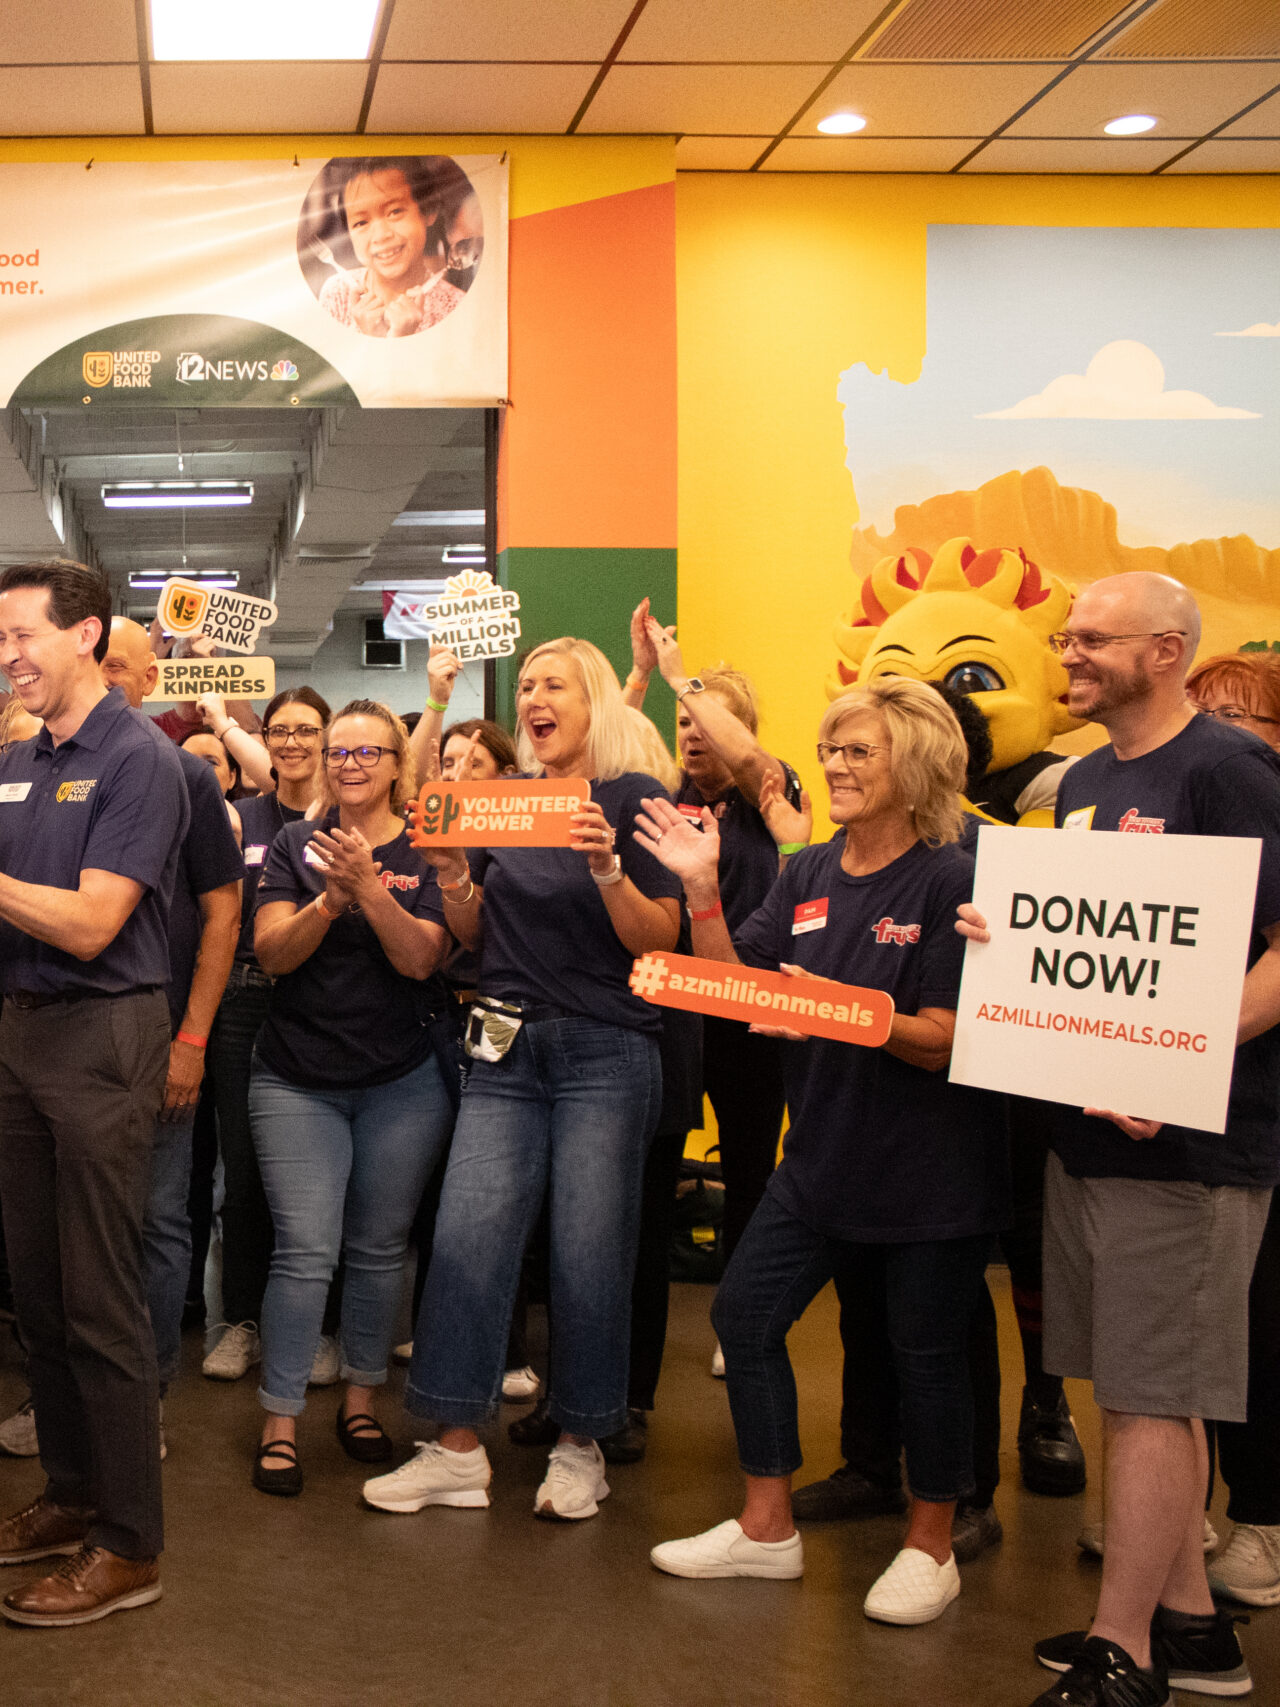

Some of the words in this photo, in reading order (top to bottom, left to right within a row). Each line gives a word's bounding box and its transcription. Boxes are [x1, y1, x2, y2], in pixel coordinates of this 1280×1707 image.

[113, 351, 161, 364] UNITED
[113, 363, 151, 376] FOOD
[113, 375, 152, 388] BANK
[210, 593, 272, 621] UNITED
[426, 594, 515, 620] SUMMER
[205, 608, 255, 632] FOOD
[460, 617, 473, 626] OF
[202, 623, 252, 648] BANK
[431, 621, 517, 645] MILLION
[163, 664, 245, 680] SPREAD
[164, 679, 266, 695] KINDNESS
[462, 796, 581, 813] VOLUNTEER
[459, 815, 534, 832] POWER
[1009, 892, 1200, 947] DONATE
[1030, 946, 1161, 999] NOW!
[631, 956, 874, 1028] #azmillionmeals
[975, 1002, 1208, 1053] AZMILLIONMEALS.ORG
